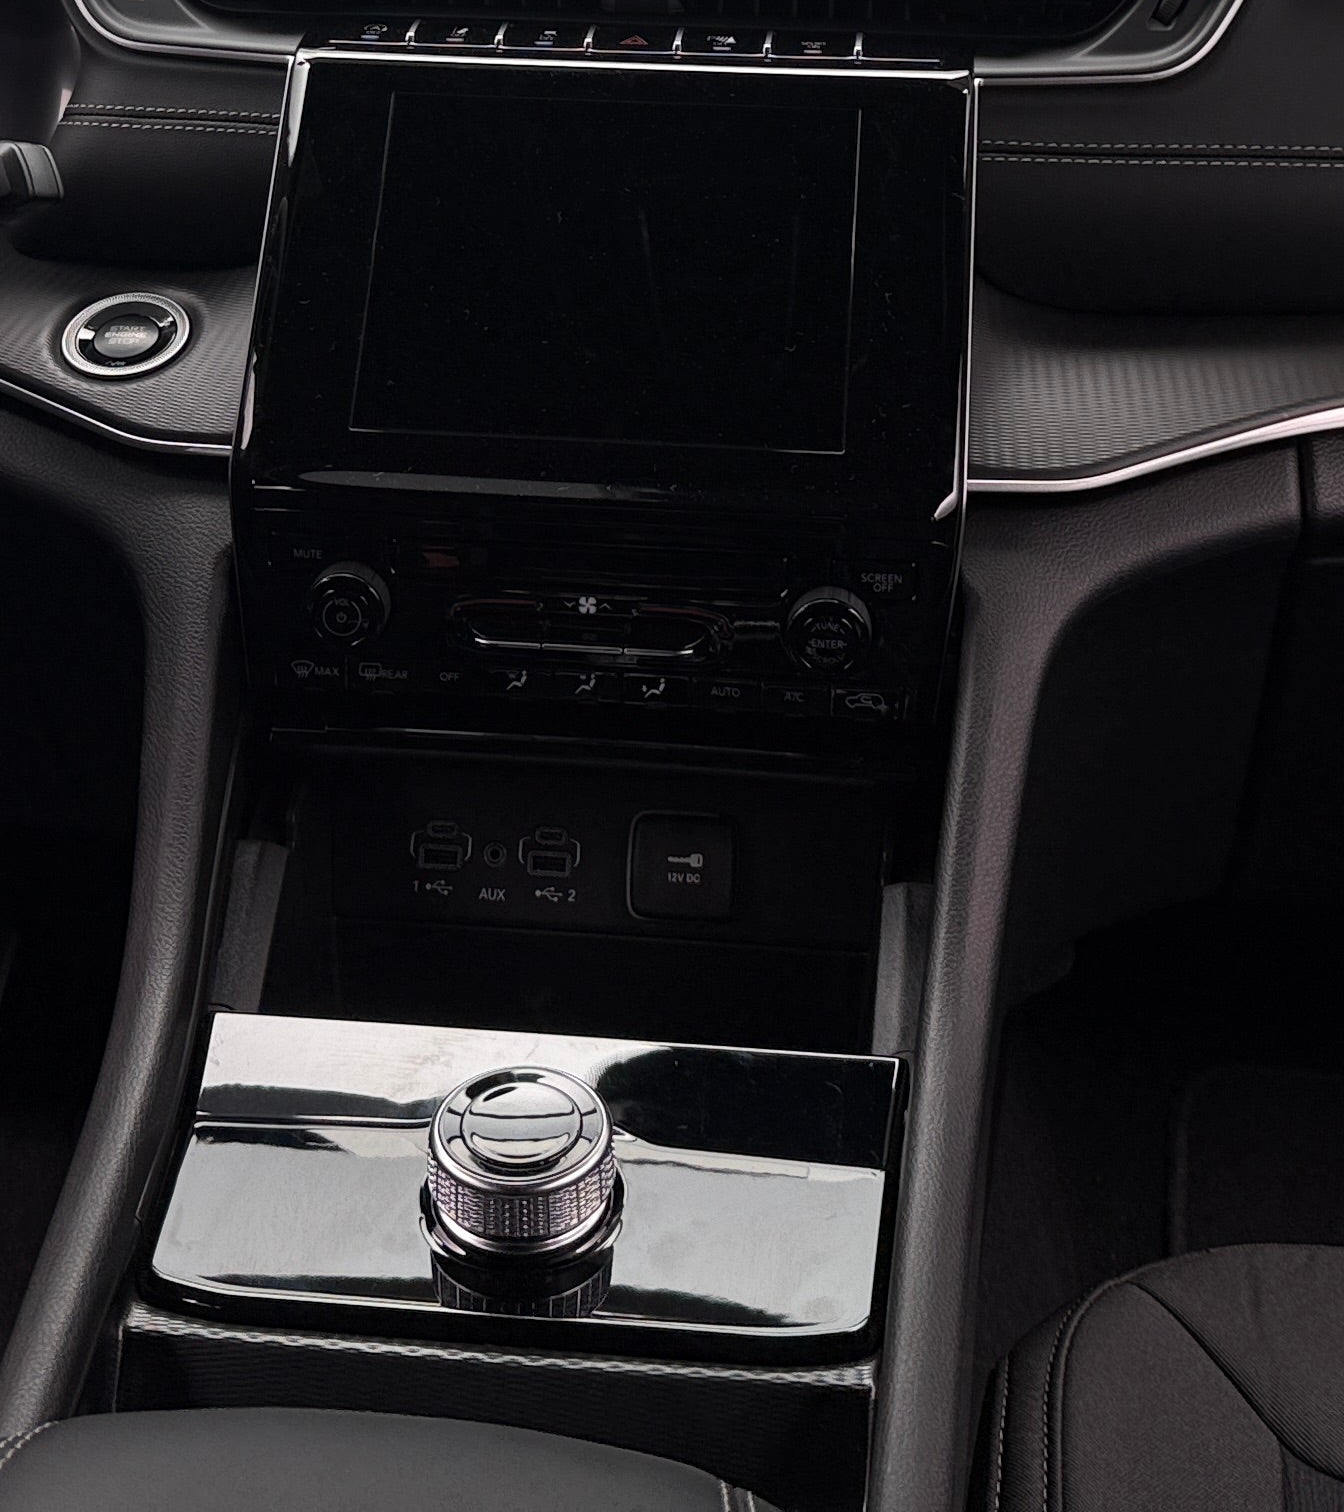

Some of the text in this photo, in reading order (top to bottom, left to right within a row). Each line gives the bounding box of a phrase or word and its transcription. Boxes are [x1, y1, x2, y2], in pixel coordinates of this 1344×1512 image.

[292, 548, 324, 560] MUTE
[860, 573, 903, 584] SCREEN
[872, 583, 894, 593] OFF
[810, 639, 845, 649] ENTER
[314, 666, 340, 677] MAX
[379, 669, 409, 679] REAR
[439, 671, 460, 682] OFF
[710, 687, 741, 698] AUTO
[667, 872, 702, 884] 12V DC
[478, 888, 507, 902] AUX
[567, 889, 577, 902] 2
